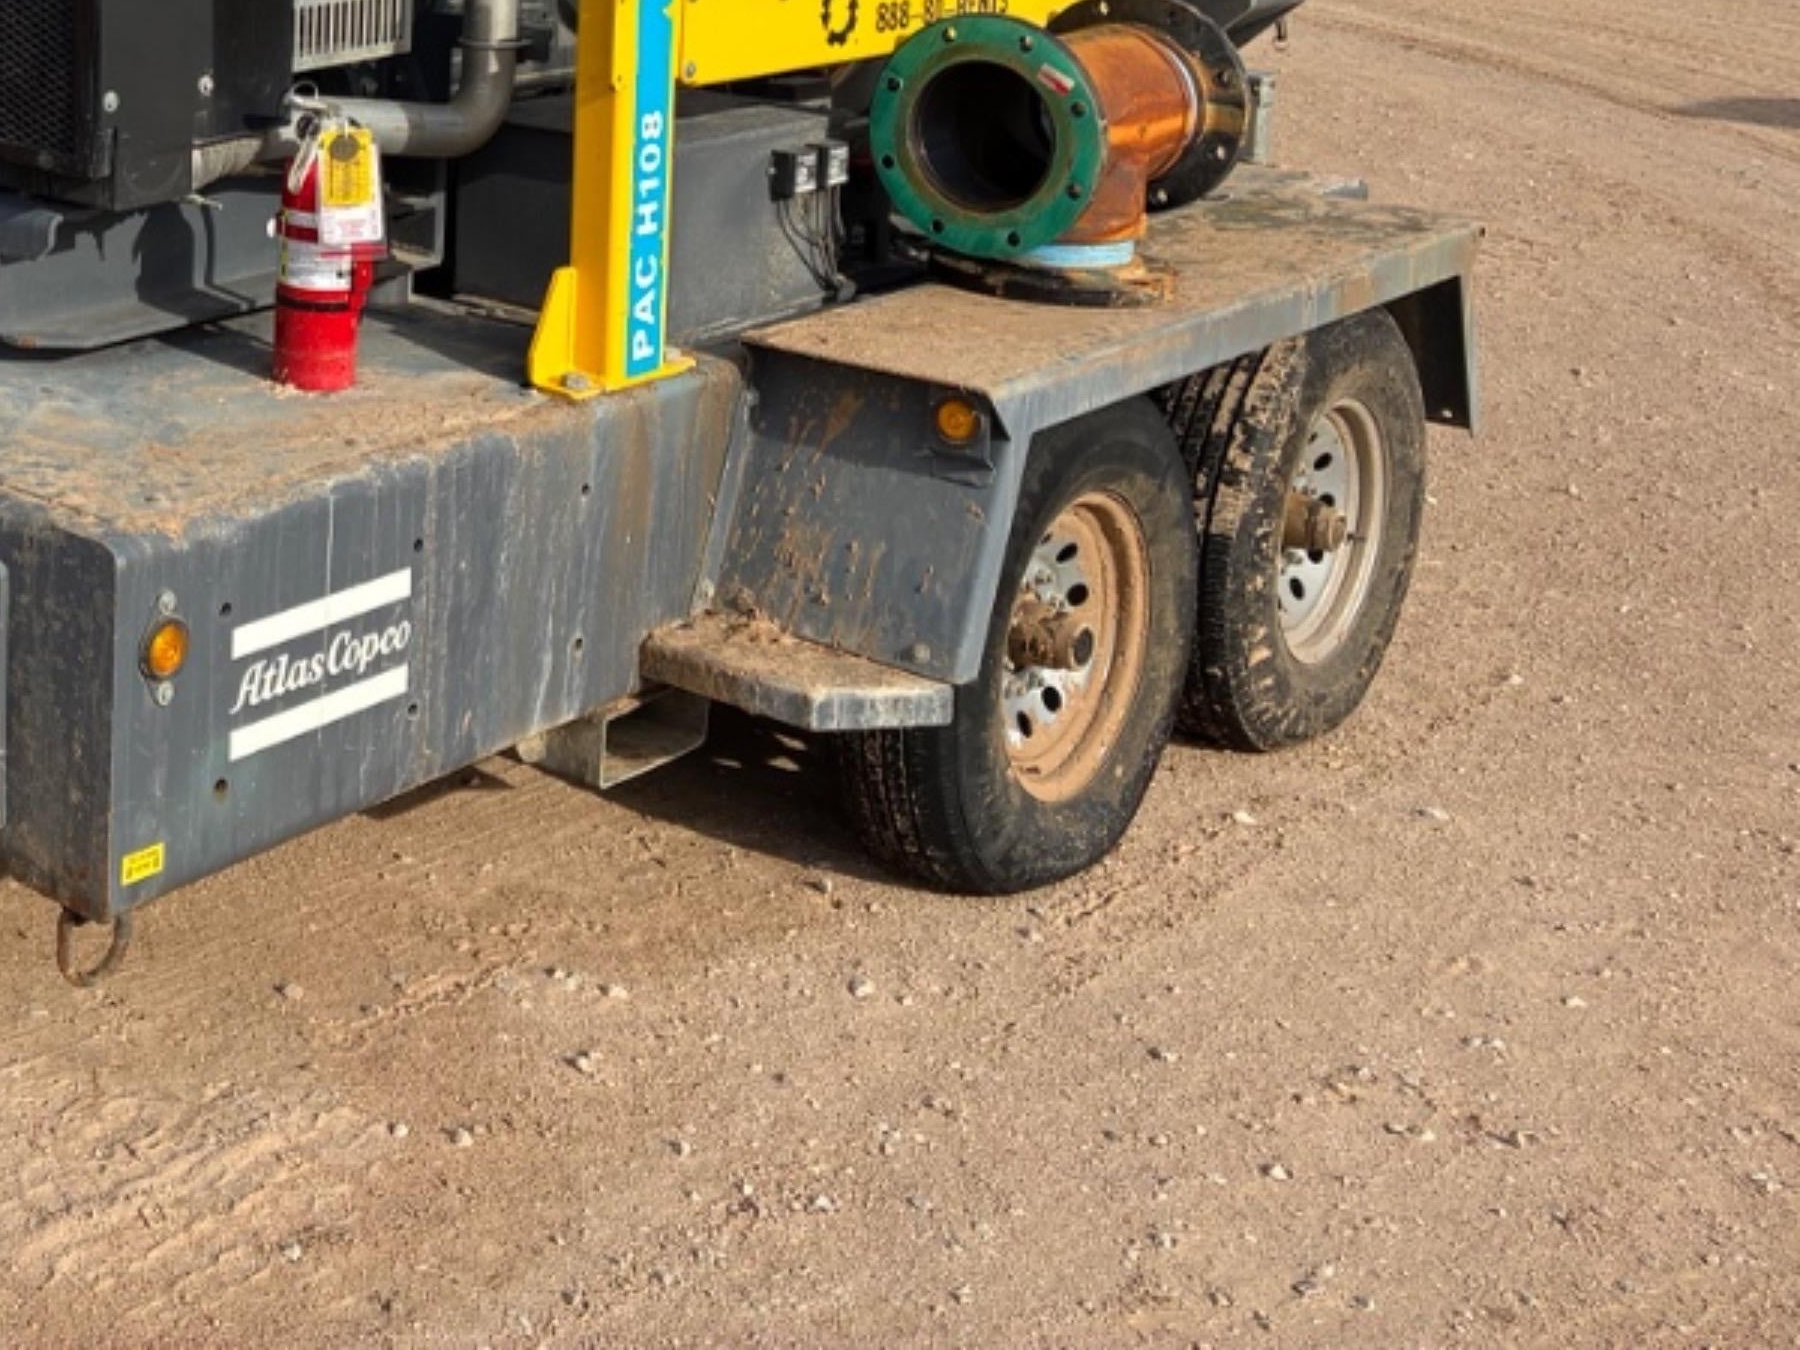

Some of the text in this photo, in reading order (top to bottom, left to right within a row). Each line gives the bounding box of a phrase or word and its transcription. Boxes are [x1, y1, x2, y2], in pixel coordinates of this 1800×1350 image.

[631, 110, 664, 362] PAC H108
[228, 620, 412, 715] Atlas Copco
